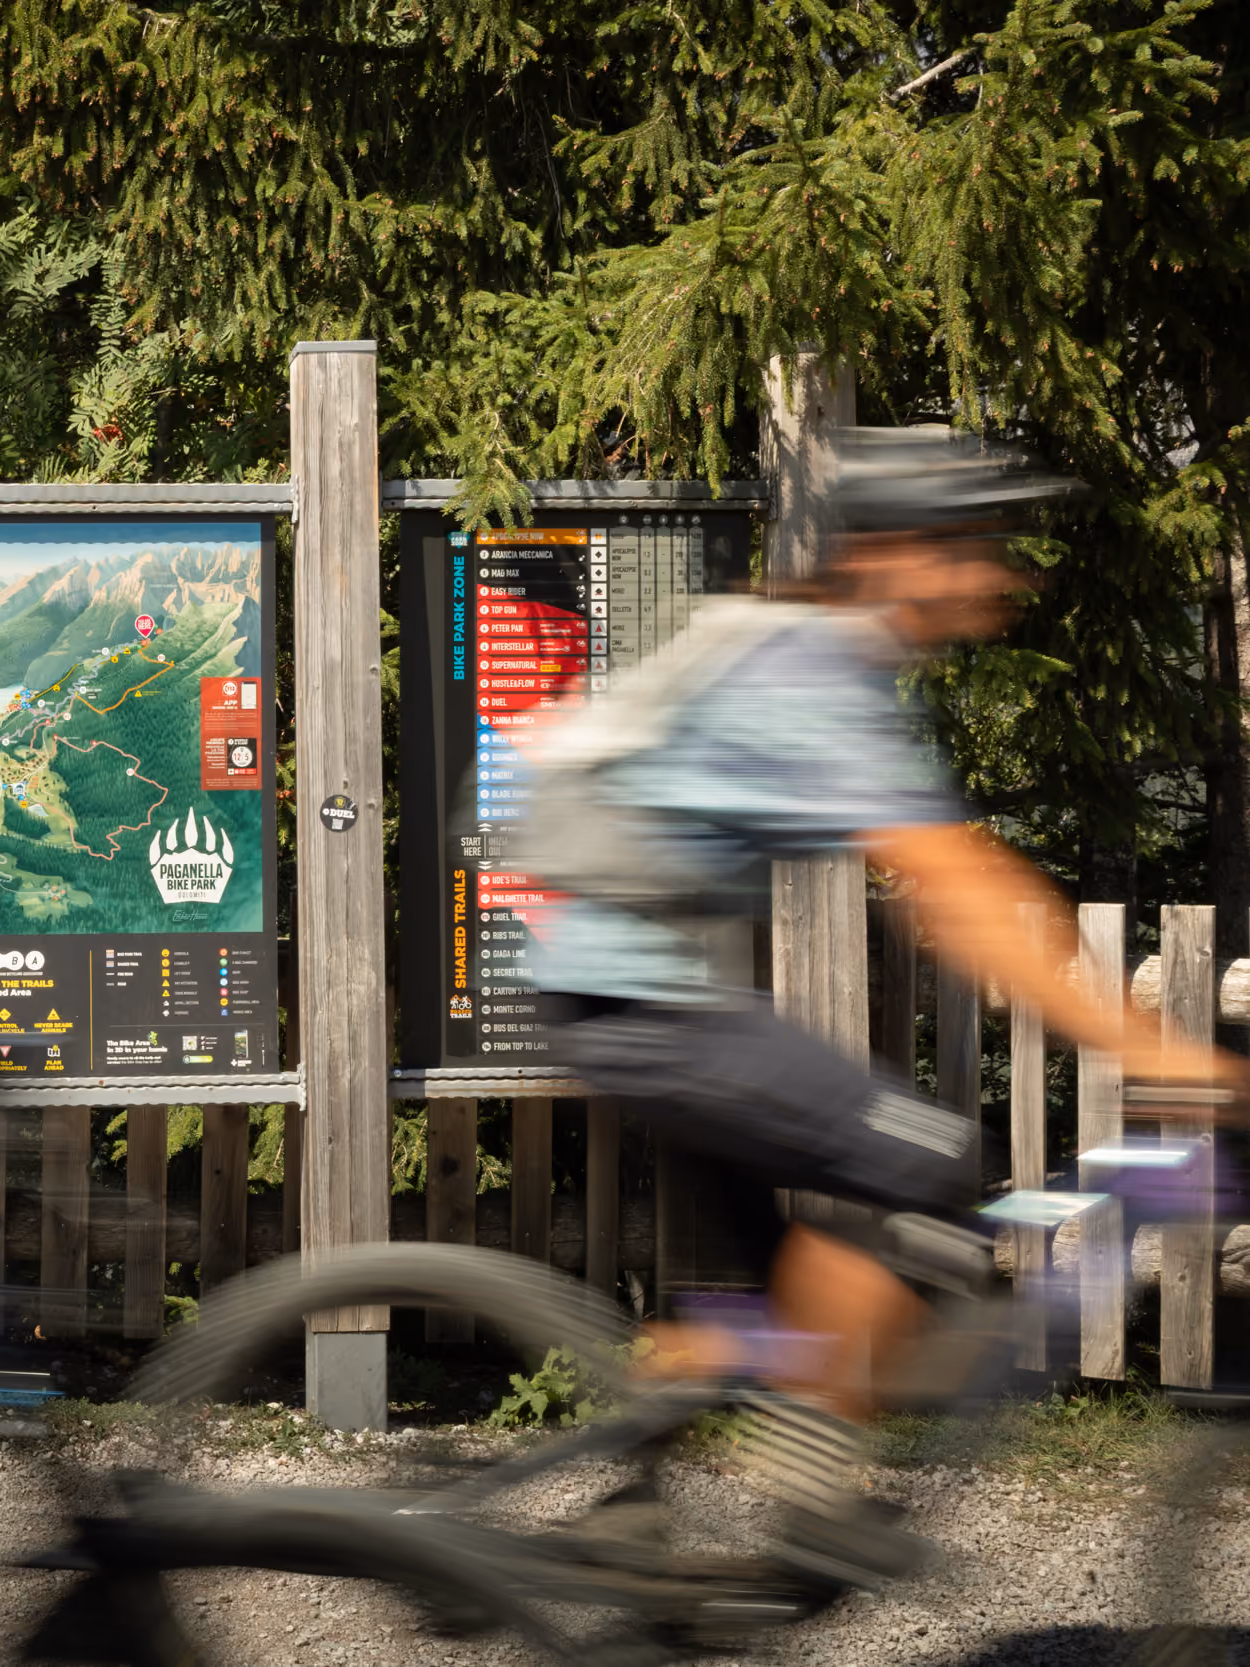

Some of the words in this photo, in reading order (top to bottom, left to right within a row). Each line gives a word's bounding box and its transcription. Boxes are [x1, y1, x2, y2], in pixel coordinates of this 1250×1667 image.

[491, 550, 517, 559] ARANCIA
[518, 550, 553, 559] MECCANICA
[453, 556, 465, 597] ZONE
[491, 569, 505, 577] MAD
[506, 569, 519, 577] MAX
[491, 588, 507, 596] EASY
[507, 588, 526, 596] RIDER
[491, 606, 503, 614] TOP
[504, 606, 517, 614] GUN
[453, 602, 465, 641] PARK
[491, 624, 510, 632] PETER
[511, 624, 523, 632] PAN
[491, 643, 534, 651] INTERSTELLAR
[453, 645, 465, 680] BIKE
[491, 661, 537, 669] SUPERNATURAL
[491, 679, 535, 688] HUSTLE&FLOW
[491, 698, 507, 706] DUEL
[491, 716, 512, 725] ZANNA
[461, 837, 481, 847] START
[463, 847, 482, 856] HERE
[160, 863, 223, 879] PAGANELLA
[167, 879, 189, 890] BIKE
[190, 879, 216, 890] PARK
[454, 870, 466, 923] TRAILS
[527, 894, 545, 903] TRAIL
[511, 912, 527, 920] TRAIL
[508, 931, 526, 939] TRAIL
[454, 926, 466, 988] SHARED
[493, 950, 511, 958] GIADA
[493, 968, 516, 976] SECRET
[1, 980, 19, 988] THE
[21, 980, 54, 988] TRAILS
[10, 989, 31, 997] Area
[493, 1005, 514, 1013] MONTE
[515, 1005, 536, 1013] CORNO
[493, 1024, 506, 1032] BUS
[507, 1024, 519, 1032] DEL
[494, 1042, 511, 1051] FROM
[512, 1042, 524, 1051] TOP
[525, 1042, 532, 1051] TO
[533, 1042, 548, 1051] LAKE
